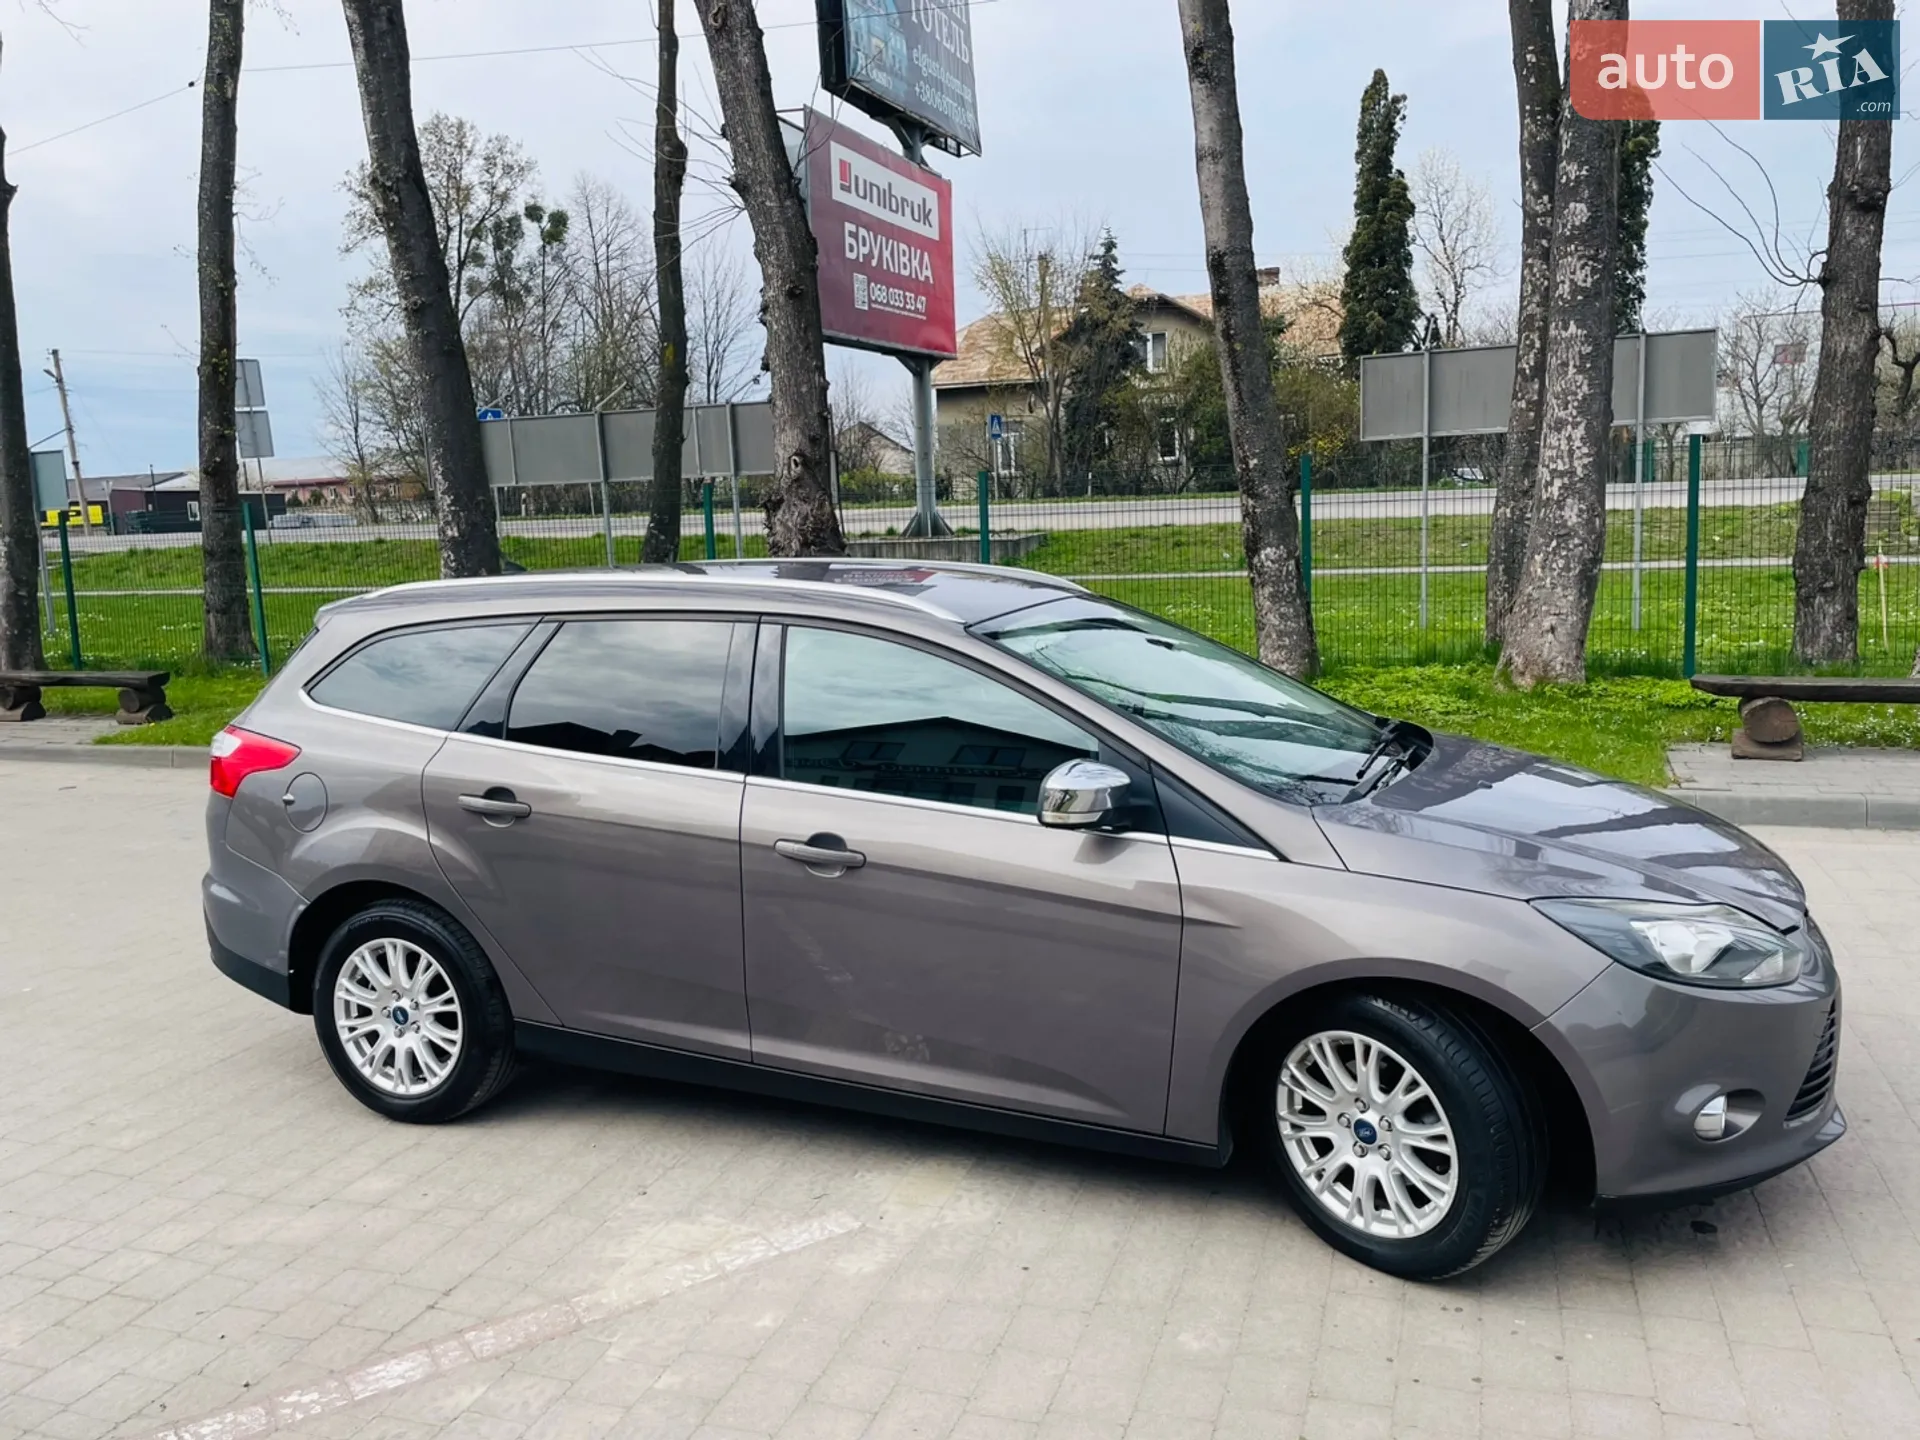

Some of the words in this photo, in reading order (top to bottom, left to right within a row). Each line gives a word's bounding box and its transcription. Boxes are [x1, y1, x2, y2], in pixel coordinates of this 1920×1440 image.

[854, 174, 934, 228] unibruk
[844, 221, 934, 285] БРУКІВКА
[869, 282, 888, 304] 068
[888, 287, 904, 308] 033
[905, 291, 915, 311] 33
[916, 295, 927, 313] 47
